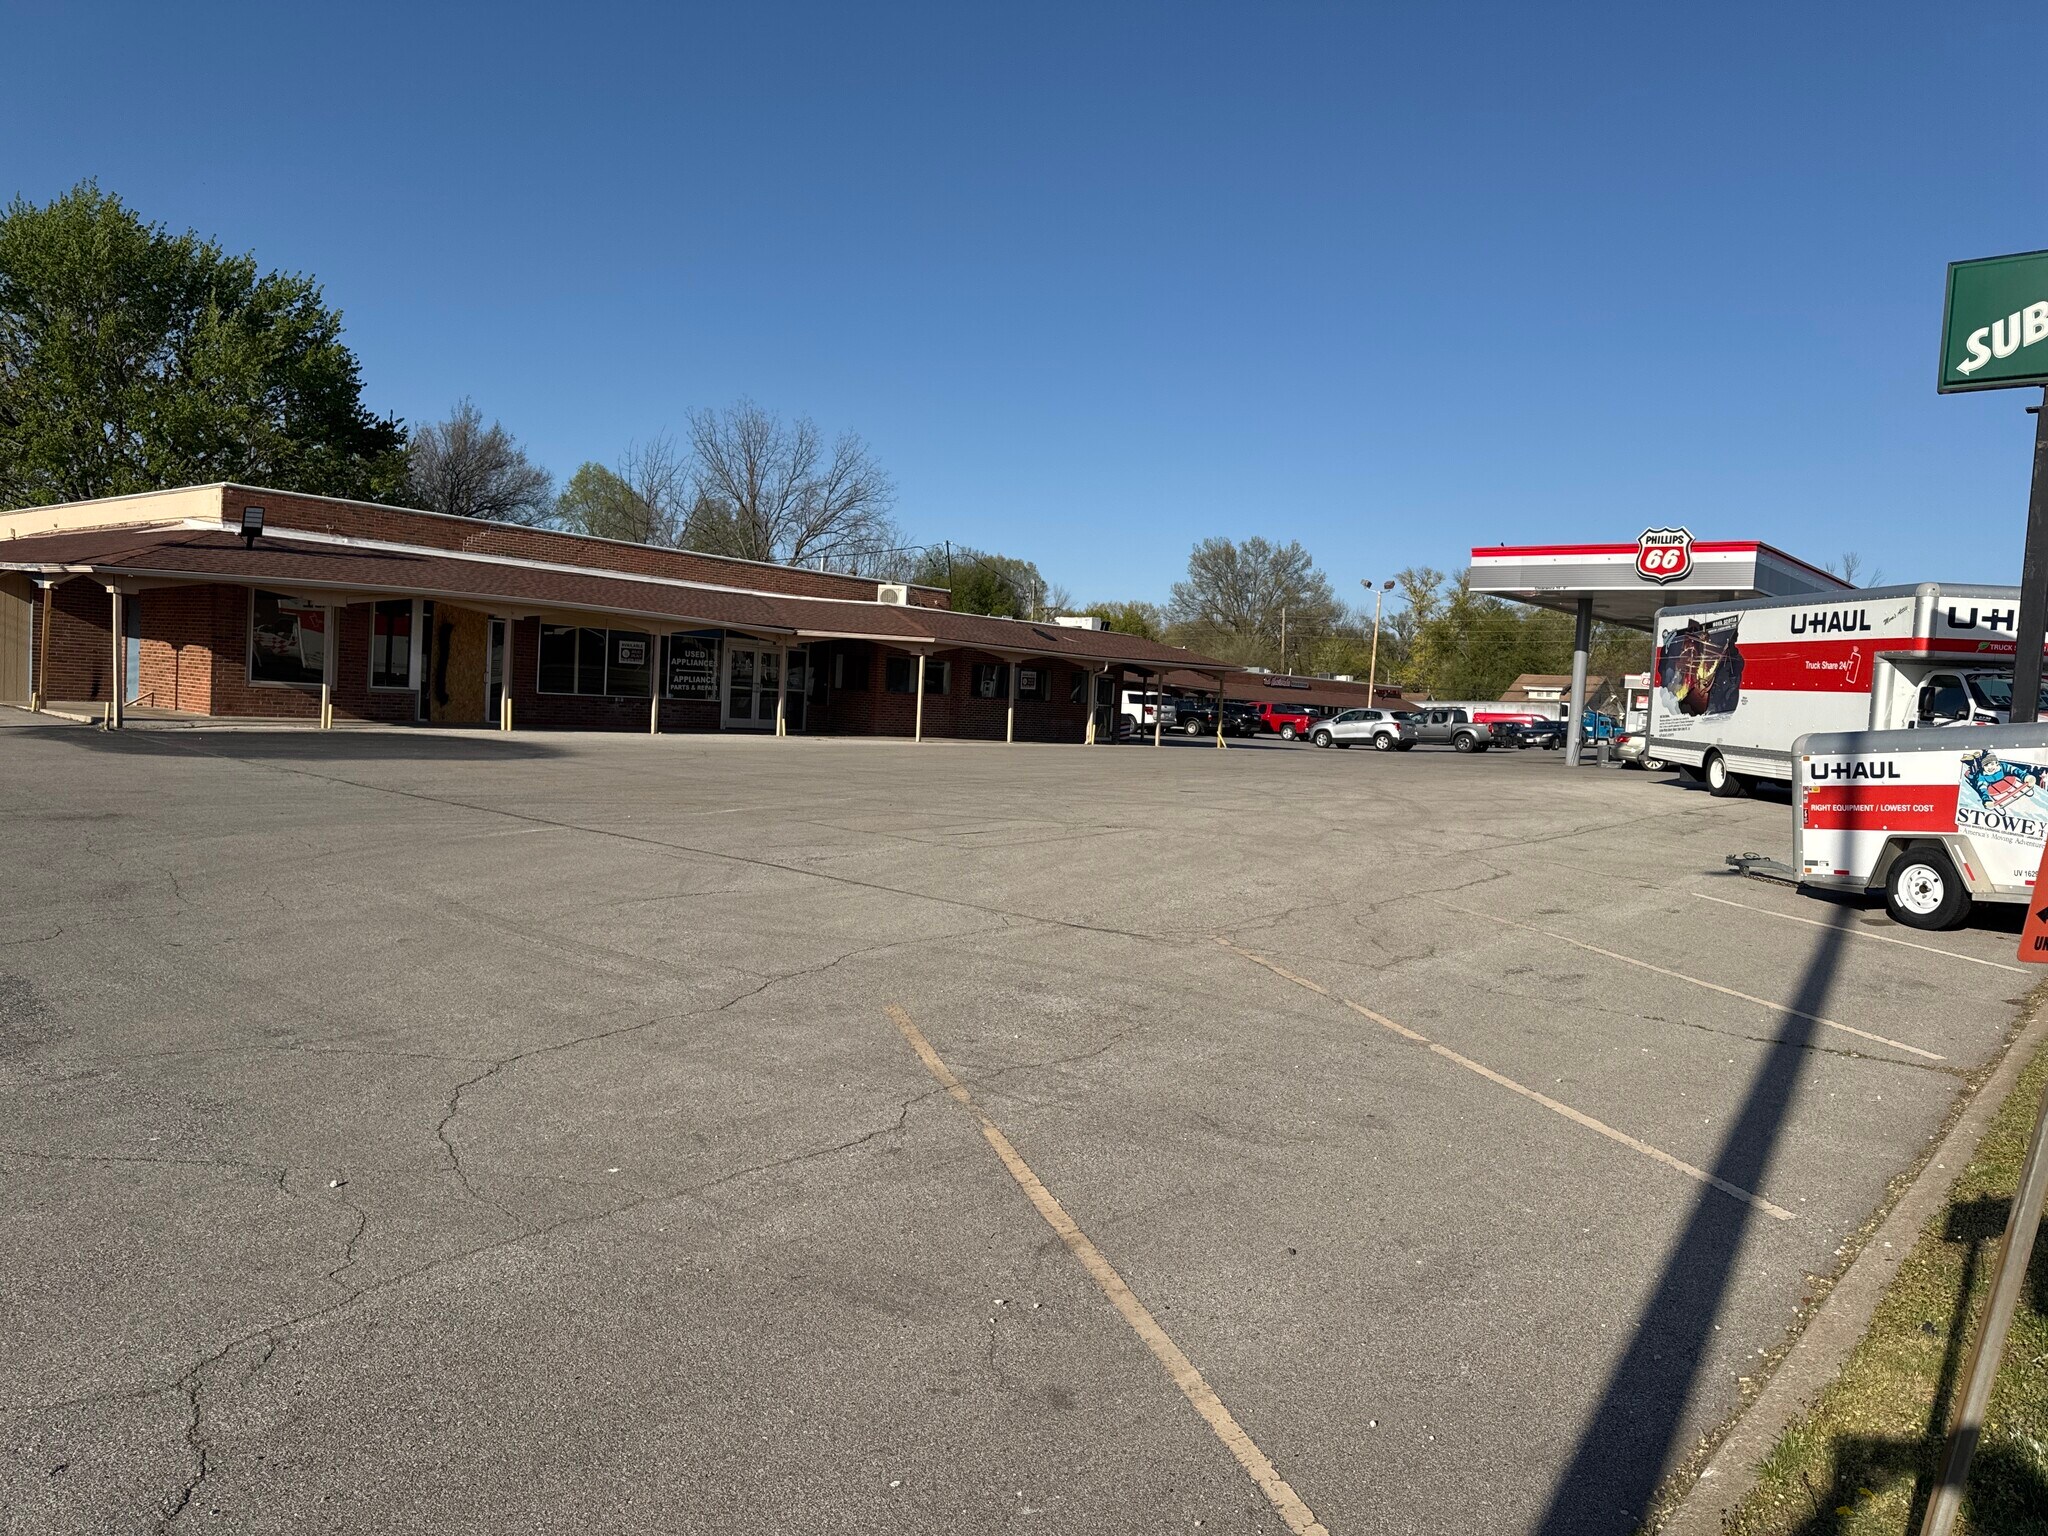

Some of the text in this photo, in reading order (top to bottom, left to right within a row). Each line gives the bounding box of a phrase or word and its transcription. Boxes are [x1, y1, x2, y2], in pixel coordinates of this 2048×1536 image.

[1645, 535, 1684, 544] PHILLIPS
[1645, 549, 1680, 569] 66
[1790, 609, 1871, 634] U-HAUL
[685, 650, 705, 658] USED
[671, 658, 718, 667] APPLIANCES
[1805, 660, 1854, 671] Truck Share 24/7
[673, 675, 715, 684] APPLIANCE
[1810, 761, 1901, 779] U-HAUL
[1875, 804, 1879, 812] /
[1957, 807, 2035, 836] STOWE
[1963, 828, 1990, 838] America's
[1991, 833, 2013, 844] Moving
[2013, 869, 2023, 877] UV
